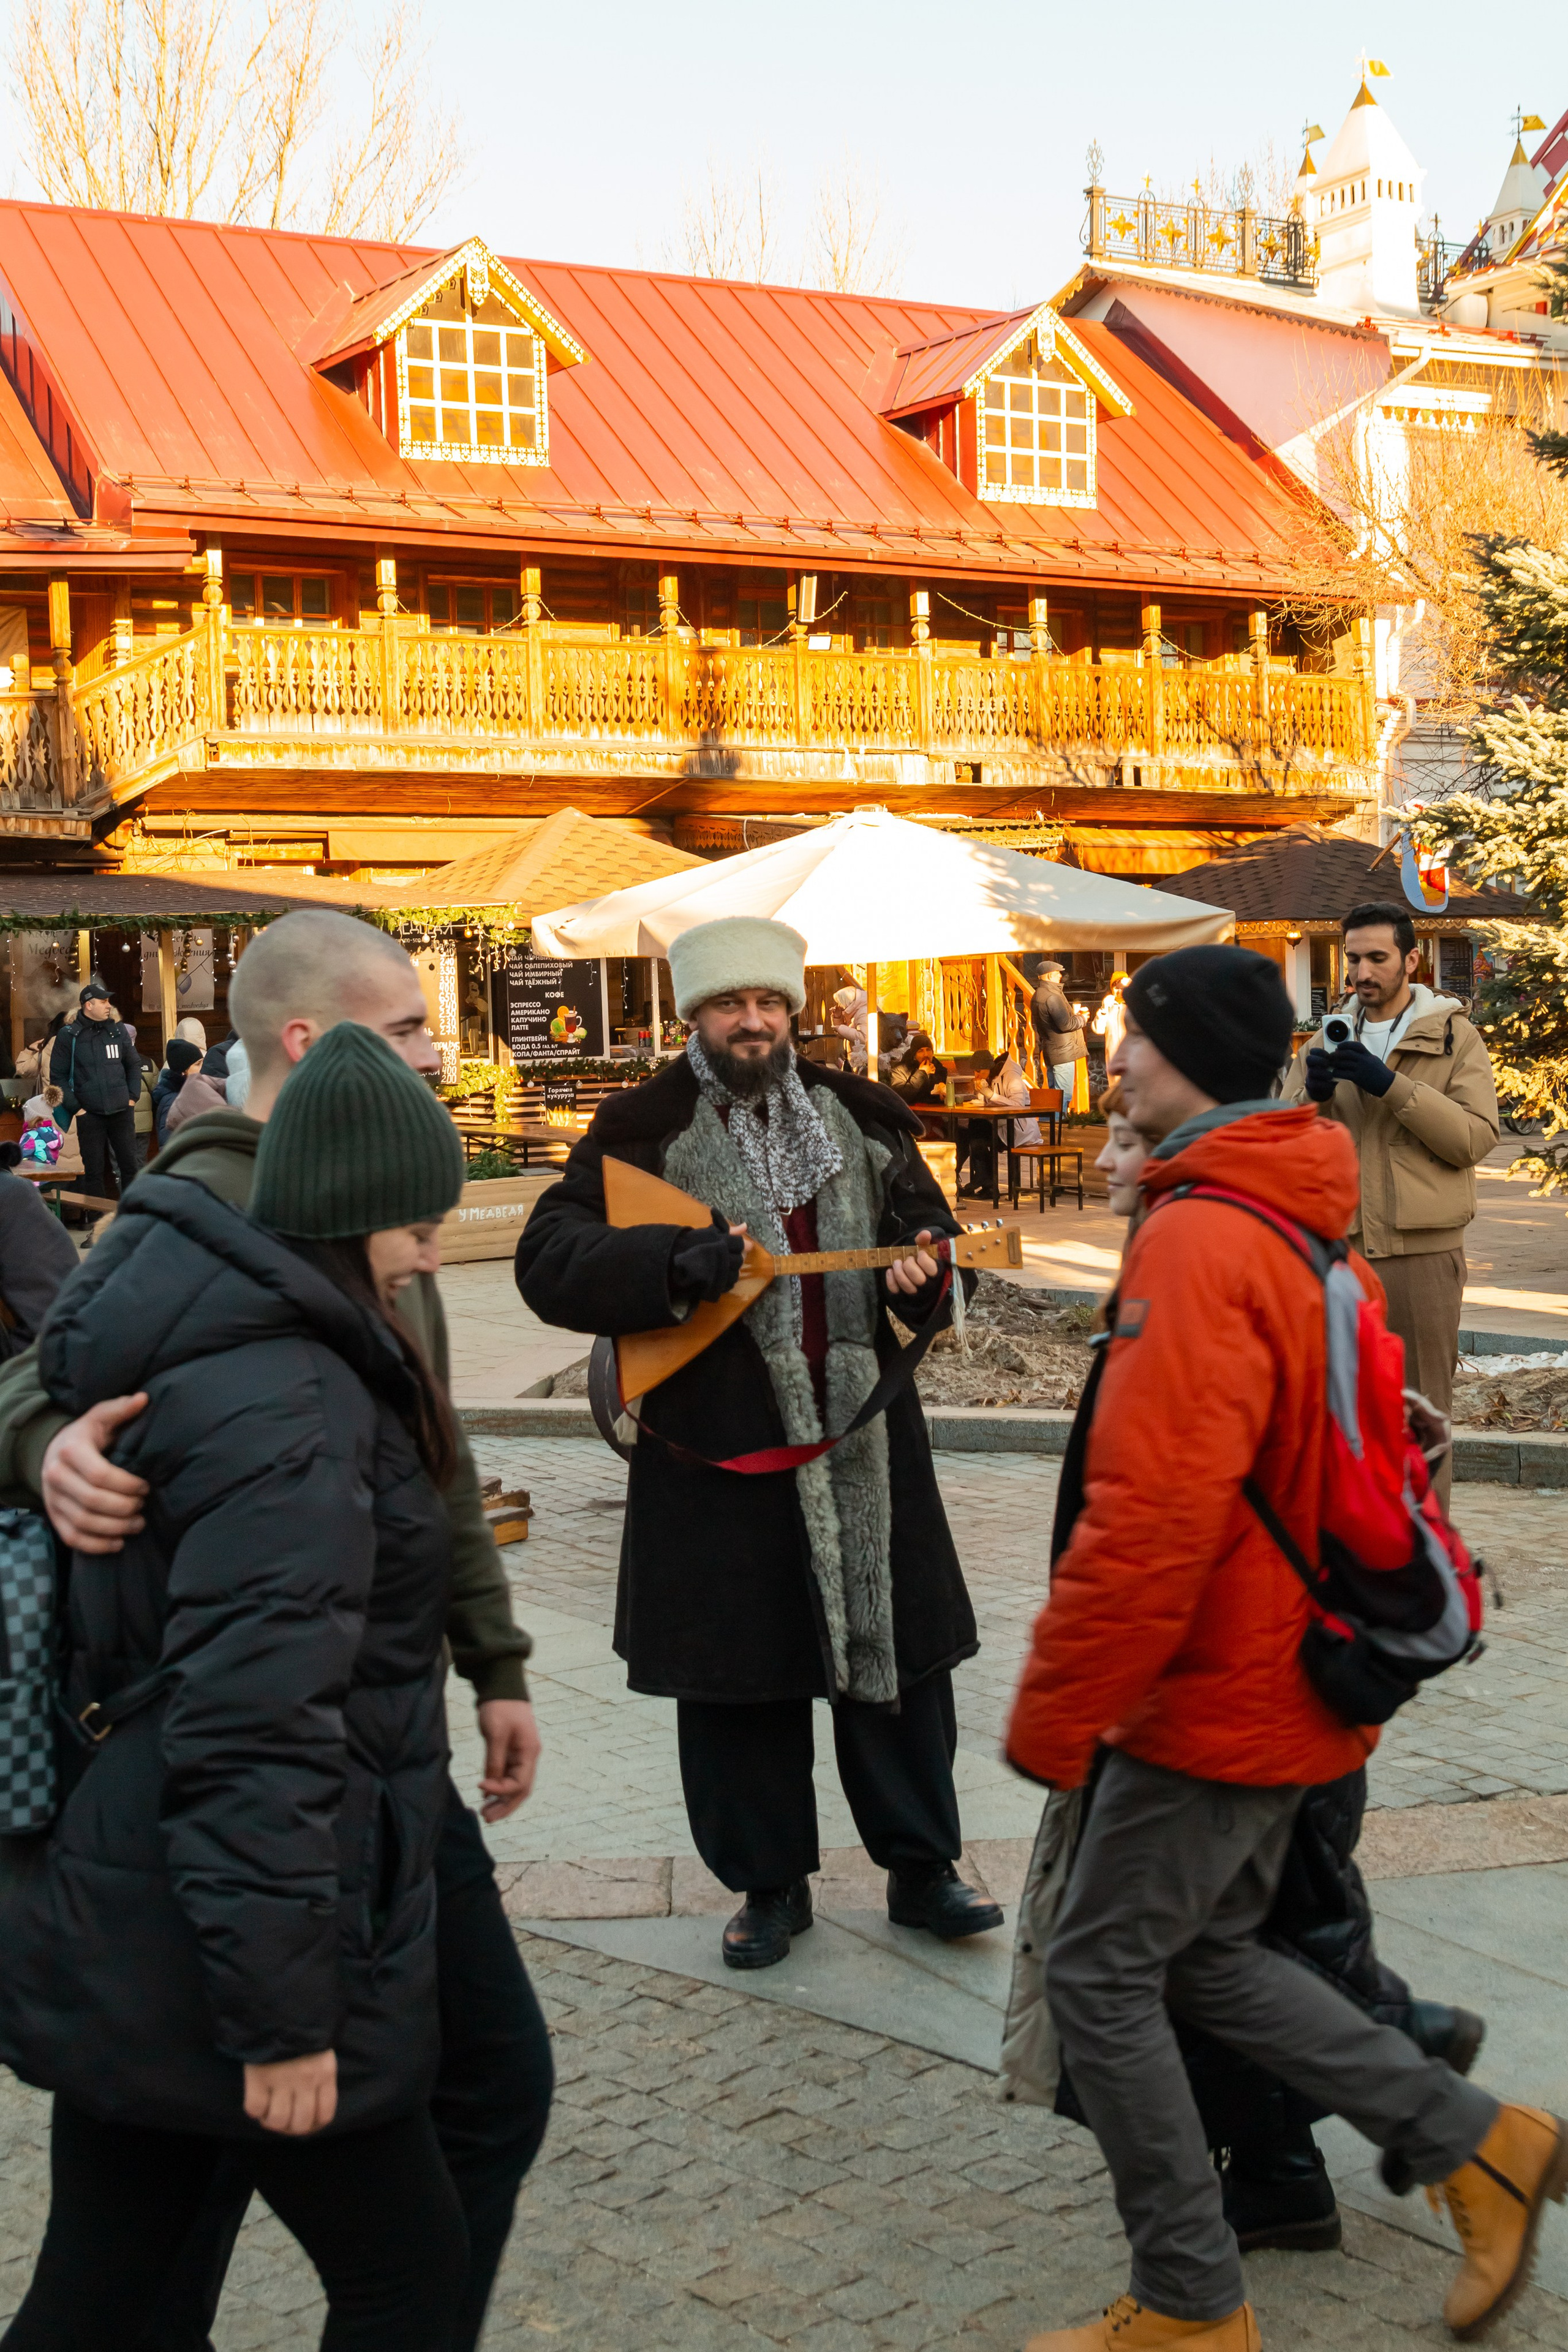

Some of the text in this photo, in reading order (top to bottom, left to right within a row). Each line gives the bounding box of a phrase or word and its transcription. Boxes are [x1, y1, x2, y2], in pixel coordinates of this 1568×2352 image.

[439, 992, 456, 1002] 650
[512, 1048, 580, 1057] КОЛА/ФАНТА/СПРАЙТ
[442, 1066, 457, 1075] 400
[441, 1074, 457, 1084] 200
[459, 1204, 524, 1222] У МЕДВЕДЯ
